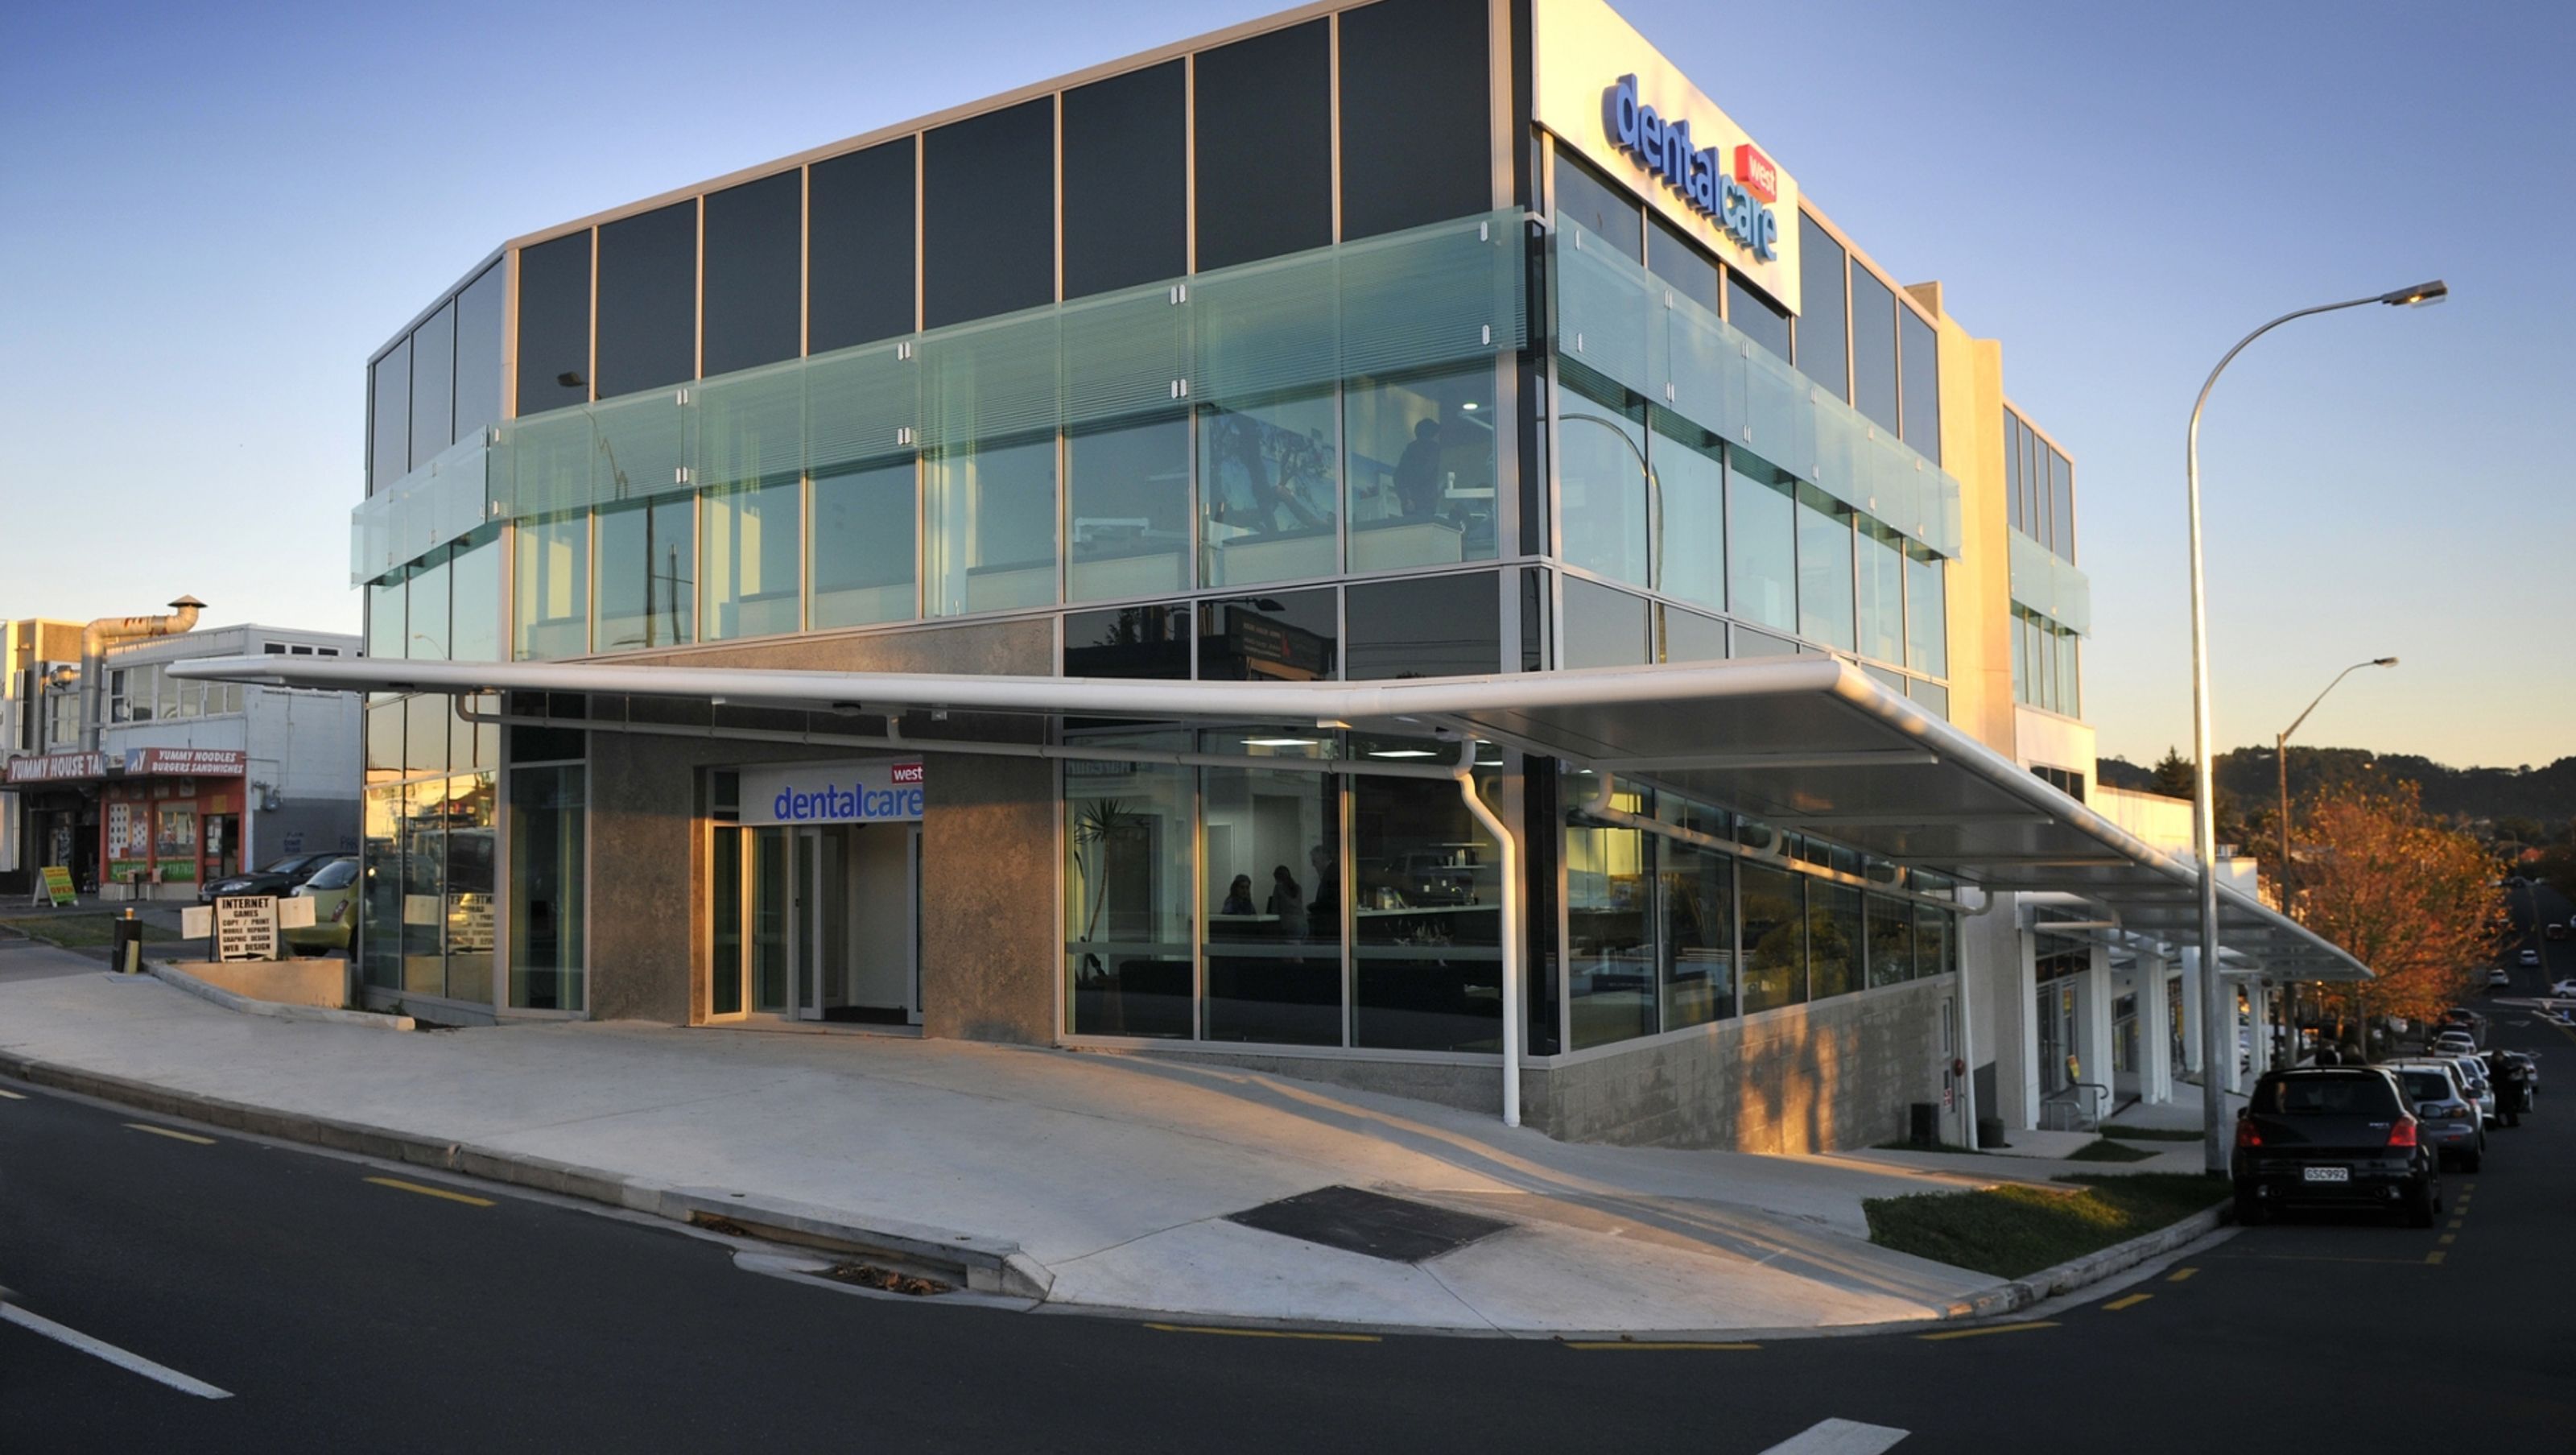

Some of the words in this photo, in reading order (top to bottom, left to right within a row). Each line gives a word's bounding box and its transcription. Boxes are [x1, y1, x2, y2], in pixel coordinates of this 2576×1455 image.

[1602, 73, 1777, 264] dentalcare
[1748, 154, 1776, 196] west
[159, 750, 193, 761] YUMMY
[194, 750, 237, 763] NOODLES
[11, 758, 48, 780] YUMMY
[51, 754, 85, 778] HOUSE
[152, 762, 190, 772] BURGERS
[192, 763, 244, 773] SANDWICHES
[894, 766, 923, 781] west
[774, 783, 923, 820] dentalcare
[51, 886, 74, 894] OPEN
[222, 898, 270, 909] INTERNET
[233, 910, 258, 918] GAMES
[245, 943, 270, 951] DESIGN
